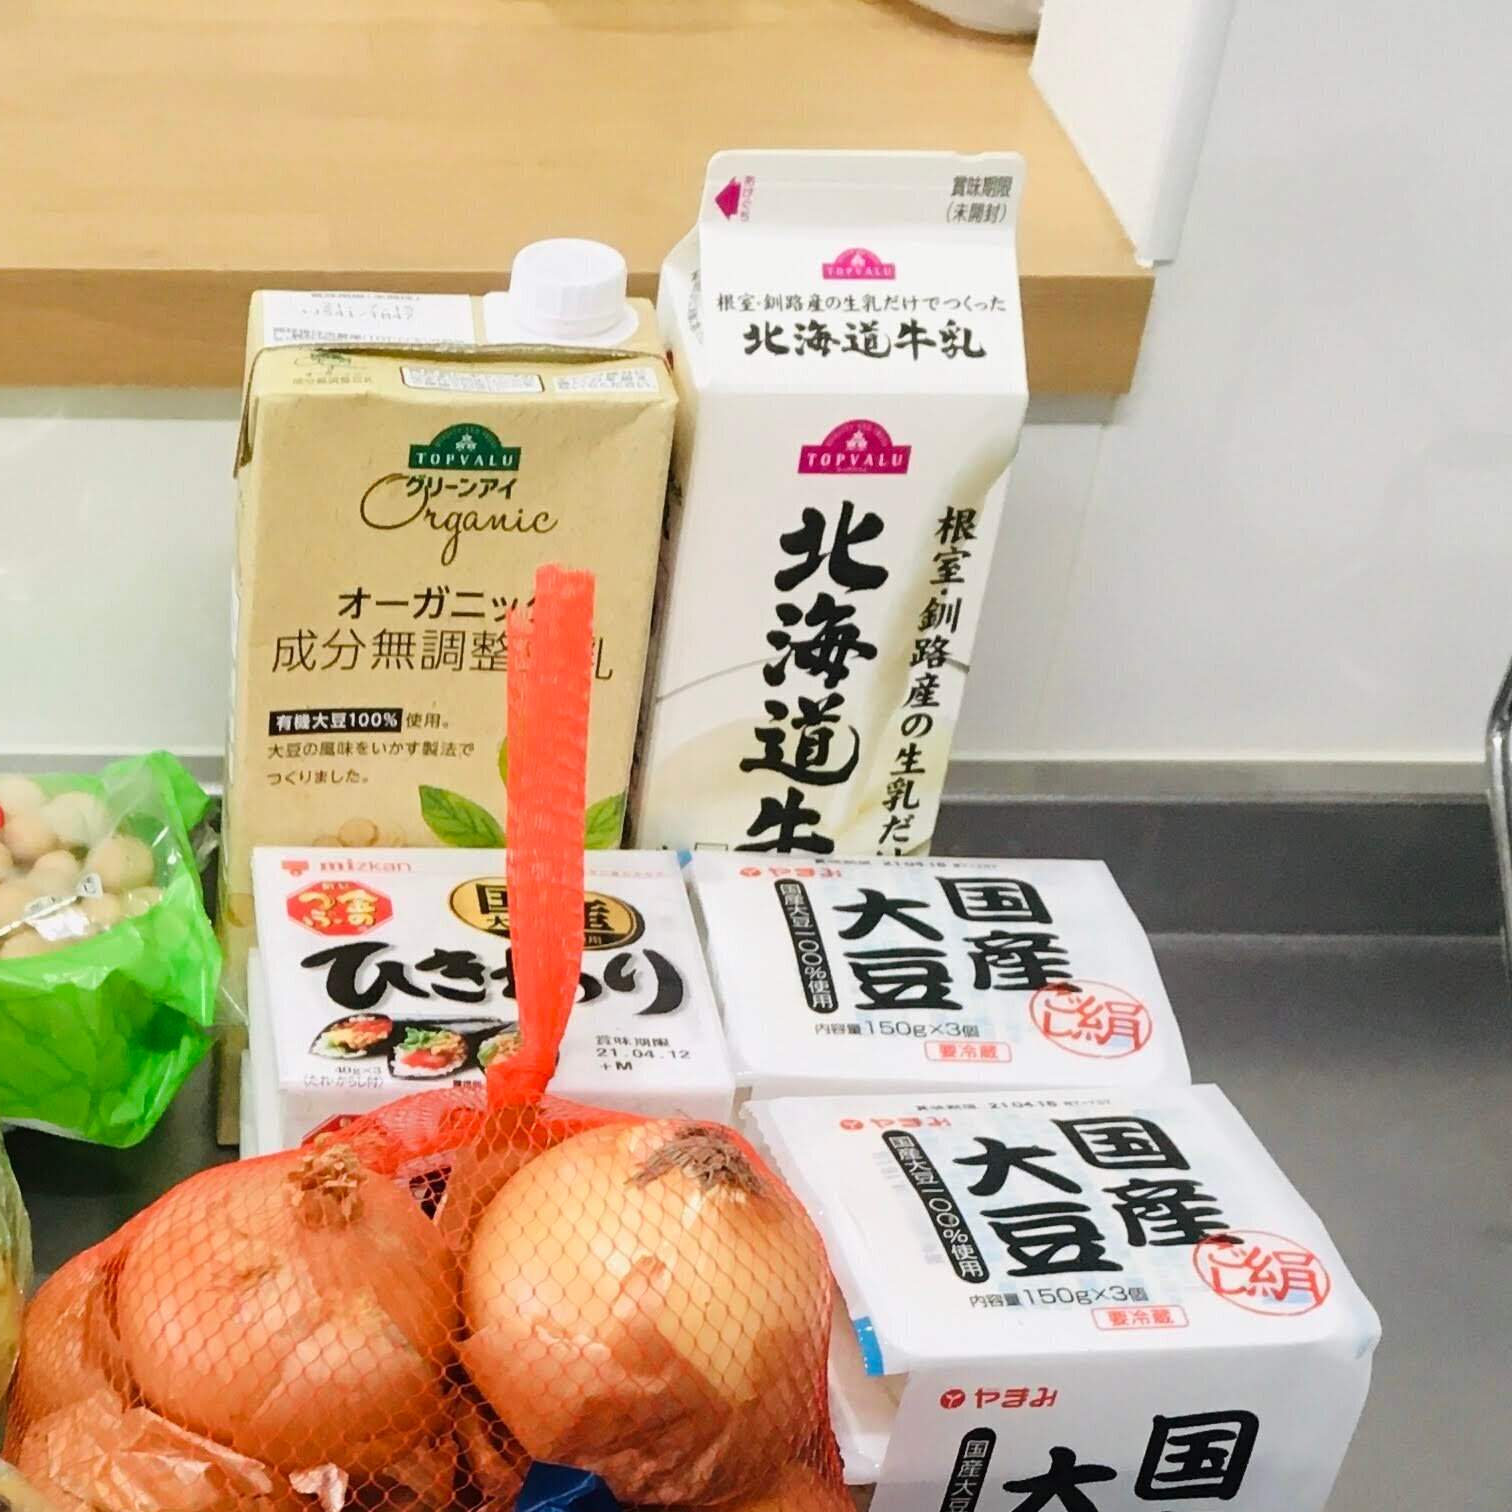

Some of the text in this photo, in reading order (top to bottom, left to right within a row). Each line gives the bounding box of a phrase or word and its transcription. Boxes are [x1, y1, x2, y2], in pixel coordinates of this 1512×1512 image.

[950, 175, 1013, 198] 賞味期限
[743, 319, 987, 360] 北海道牛乳
[415, 452, 514, 467] TOPVALU
[807, 453, 904, 467] TOPVALU
[406, 476, 519, 500] グリーンアイ
[360, 473, 558, 566] Organic
[338, 585, 537, 621] オーガニッ
[272, 628, 614, 681] 成分無調整
[274, 711, 399, 731] 有機大豆100%
[267, 740, 475, 759] 大豆の風味をいかす製法で
[266, 768, 369, 786] つくりました。
[319, 858, 413, 874] mizkan
[936, 876, 1084, 993] 国産
[832, 888, 963, 1011] 大豆
[595, 1047, 692, 1061] 21.04.12
[1052, 1116, 1244, 1248] 国産
[953, 1136, 1124, 1279] 大豆
[1107, 1309, 1174, 1328] 要冷蔵
[973, 1387, 1058, 1409] やまみ
